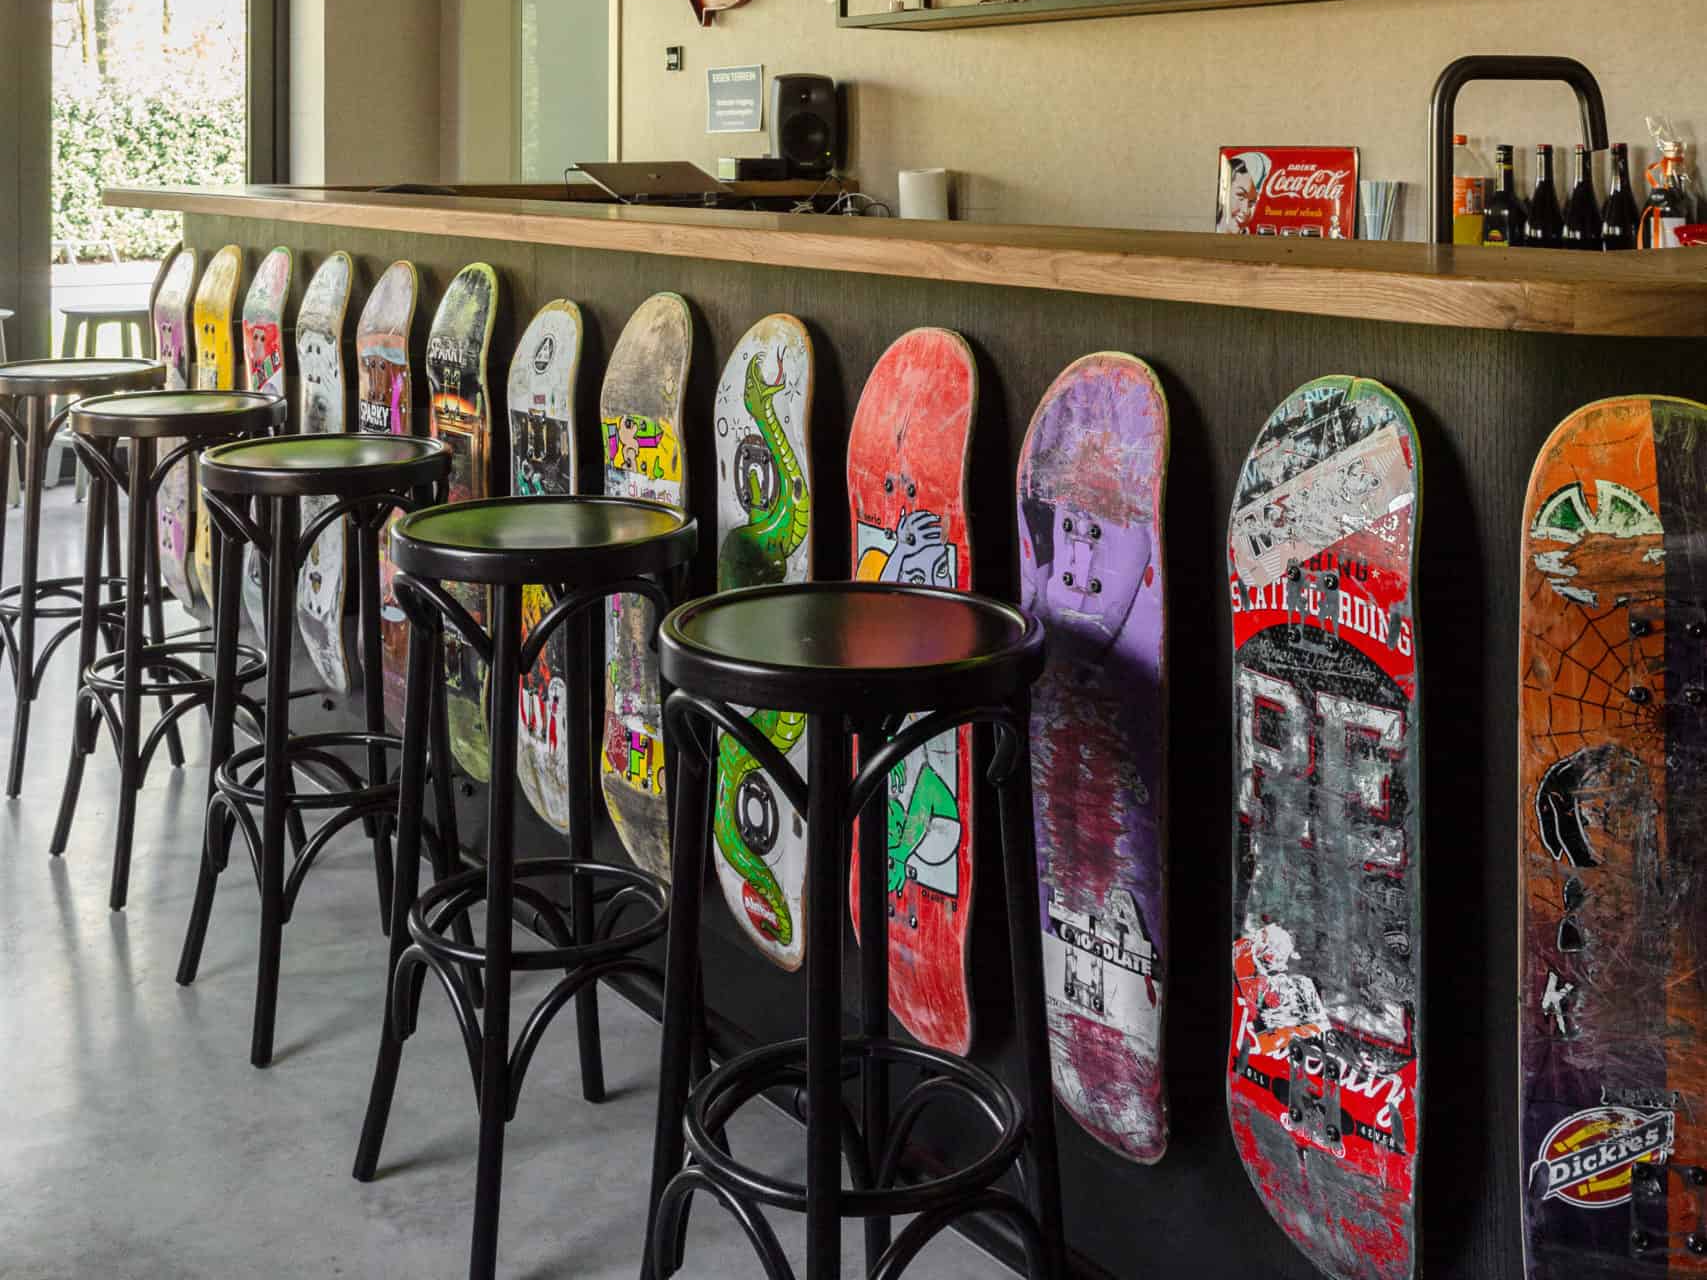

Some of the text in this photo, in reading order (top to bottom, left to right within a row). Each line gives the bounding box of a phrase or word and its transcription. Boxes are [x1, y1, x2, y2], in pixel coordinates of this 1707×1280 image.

[1265, 168, 1351, 200] Coca-Cola
[1059, 923, 1152, 977] COOLATE
[1550, 1127, 1660, 1185] Dickies
